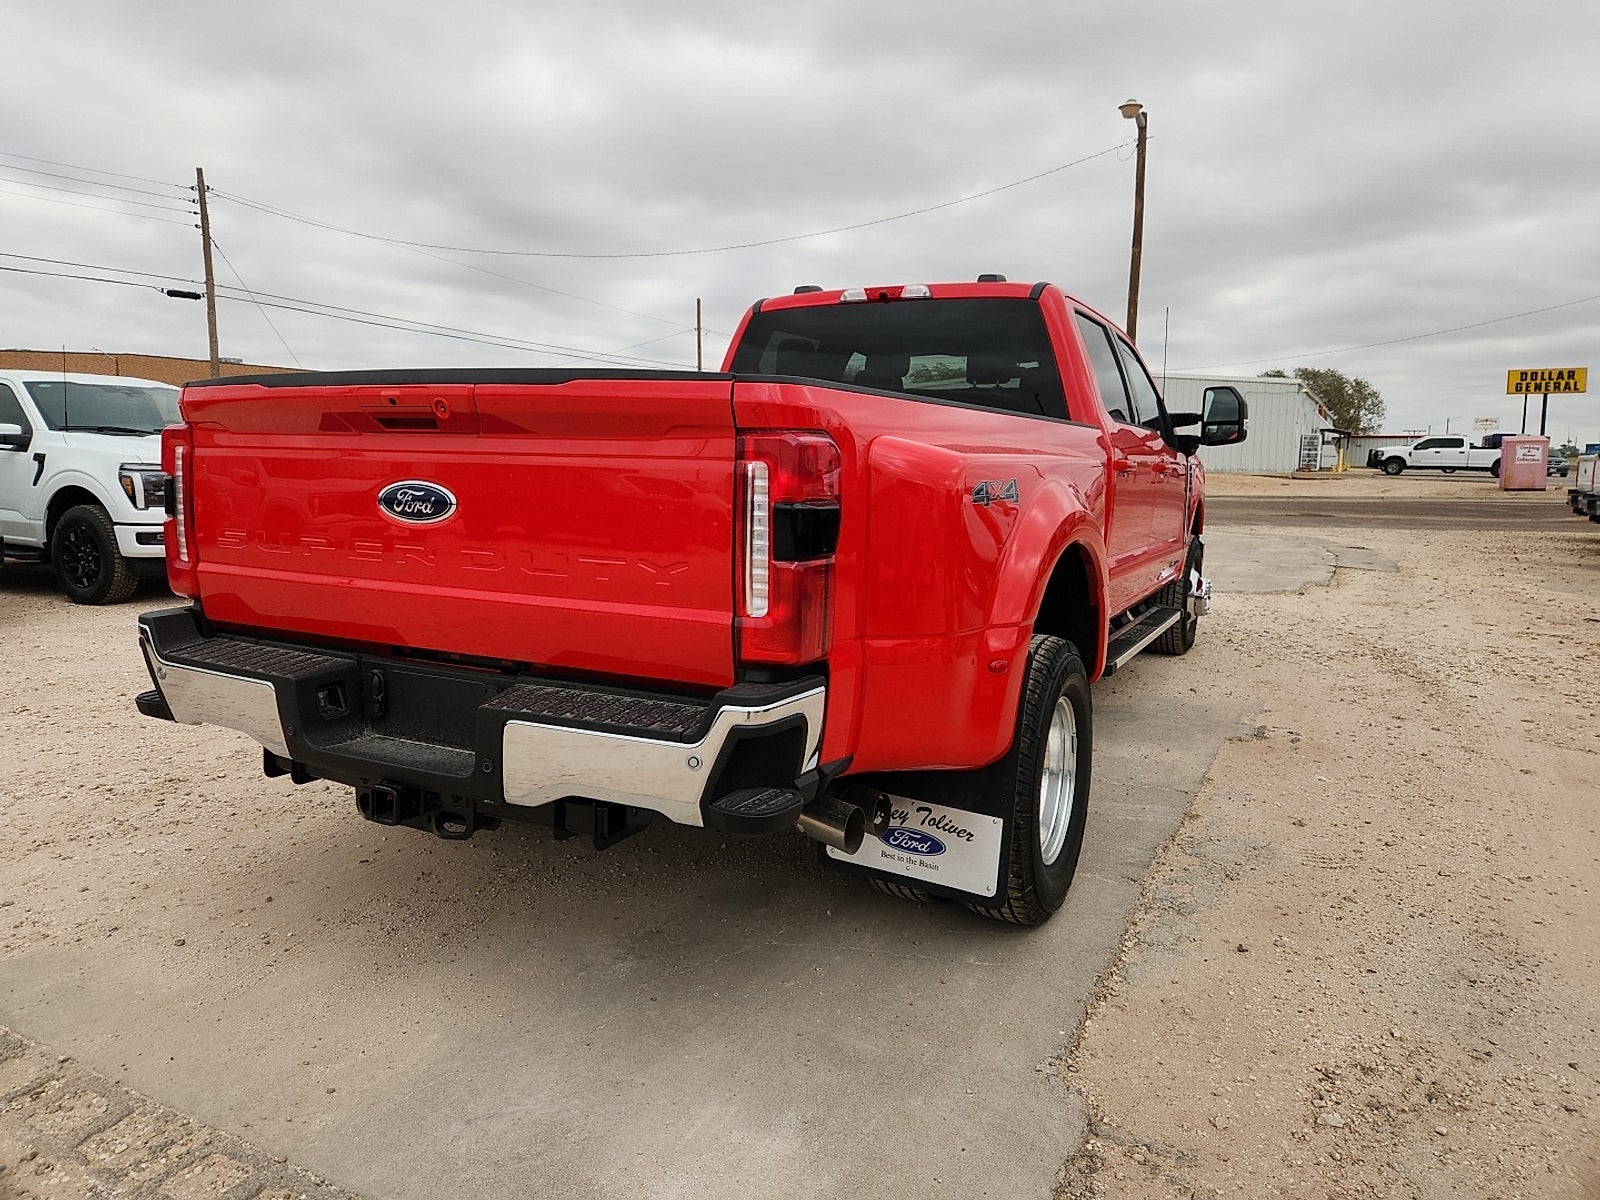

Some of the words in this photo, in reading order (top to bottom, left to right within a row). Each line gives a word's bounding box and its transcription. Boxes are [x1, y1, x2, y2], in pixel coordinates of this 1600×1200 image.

[1515, 381, 1580, 392] GENERAL
[1520, 370, 1576, 381] DOLLAR
[393, 488, 436, 514] Ford
[217, 529, 436, 567] SUPER
[460, 547, 690, 586] DUTY
[915, 806, 975, 842] Toliver
[889, 829, 932, 853] Ford
[881, 850, 896, 860] Best
[896, 853, 905, 862] in
[906, 856, 918, 866] the
[919, 859, 939, 871] Basin
